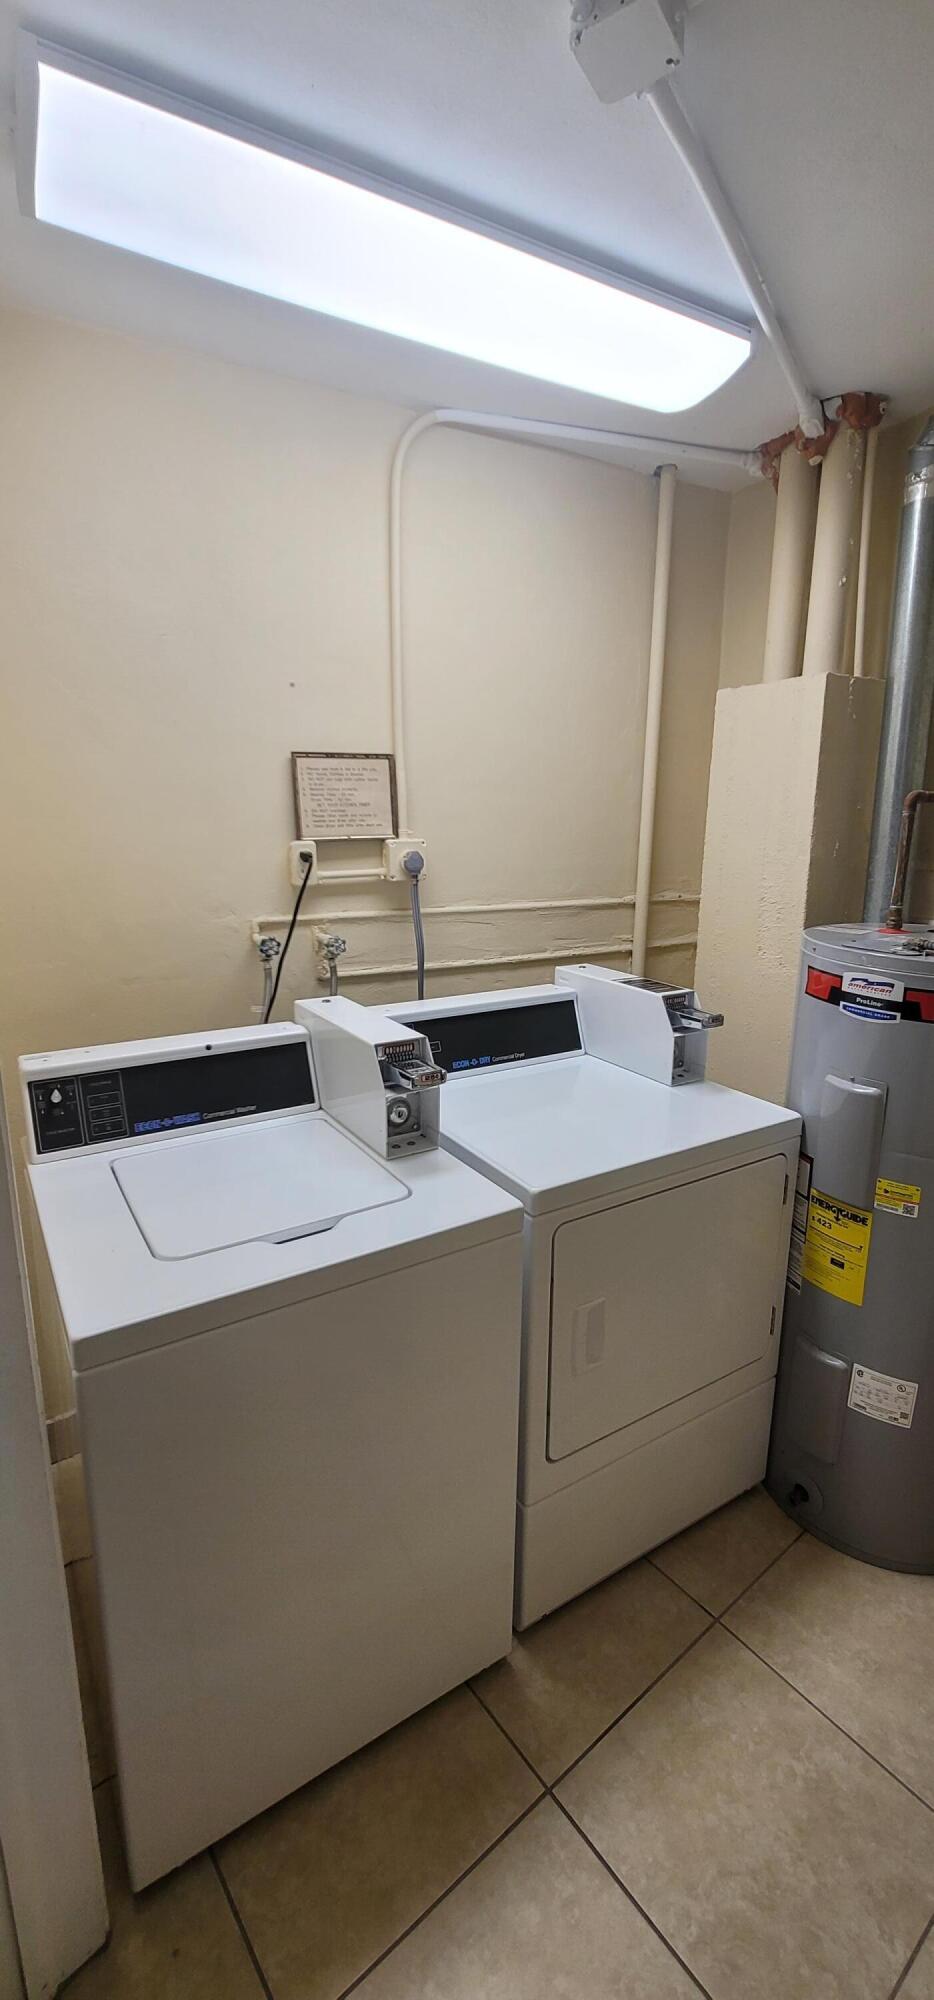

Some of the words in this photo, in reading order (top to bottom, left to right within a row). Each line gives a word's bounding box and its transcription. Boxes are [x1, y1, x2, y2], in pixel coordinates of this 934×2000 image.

[848, 982, 893, 994] american
[856, 997, 882, 1007] ProLine
[514, 1052, 526, 1060] Dryer
